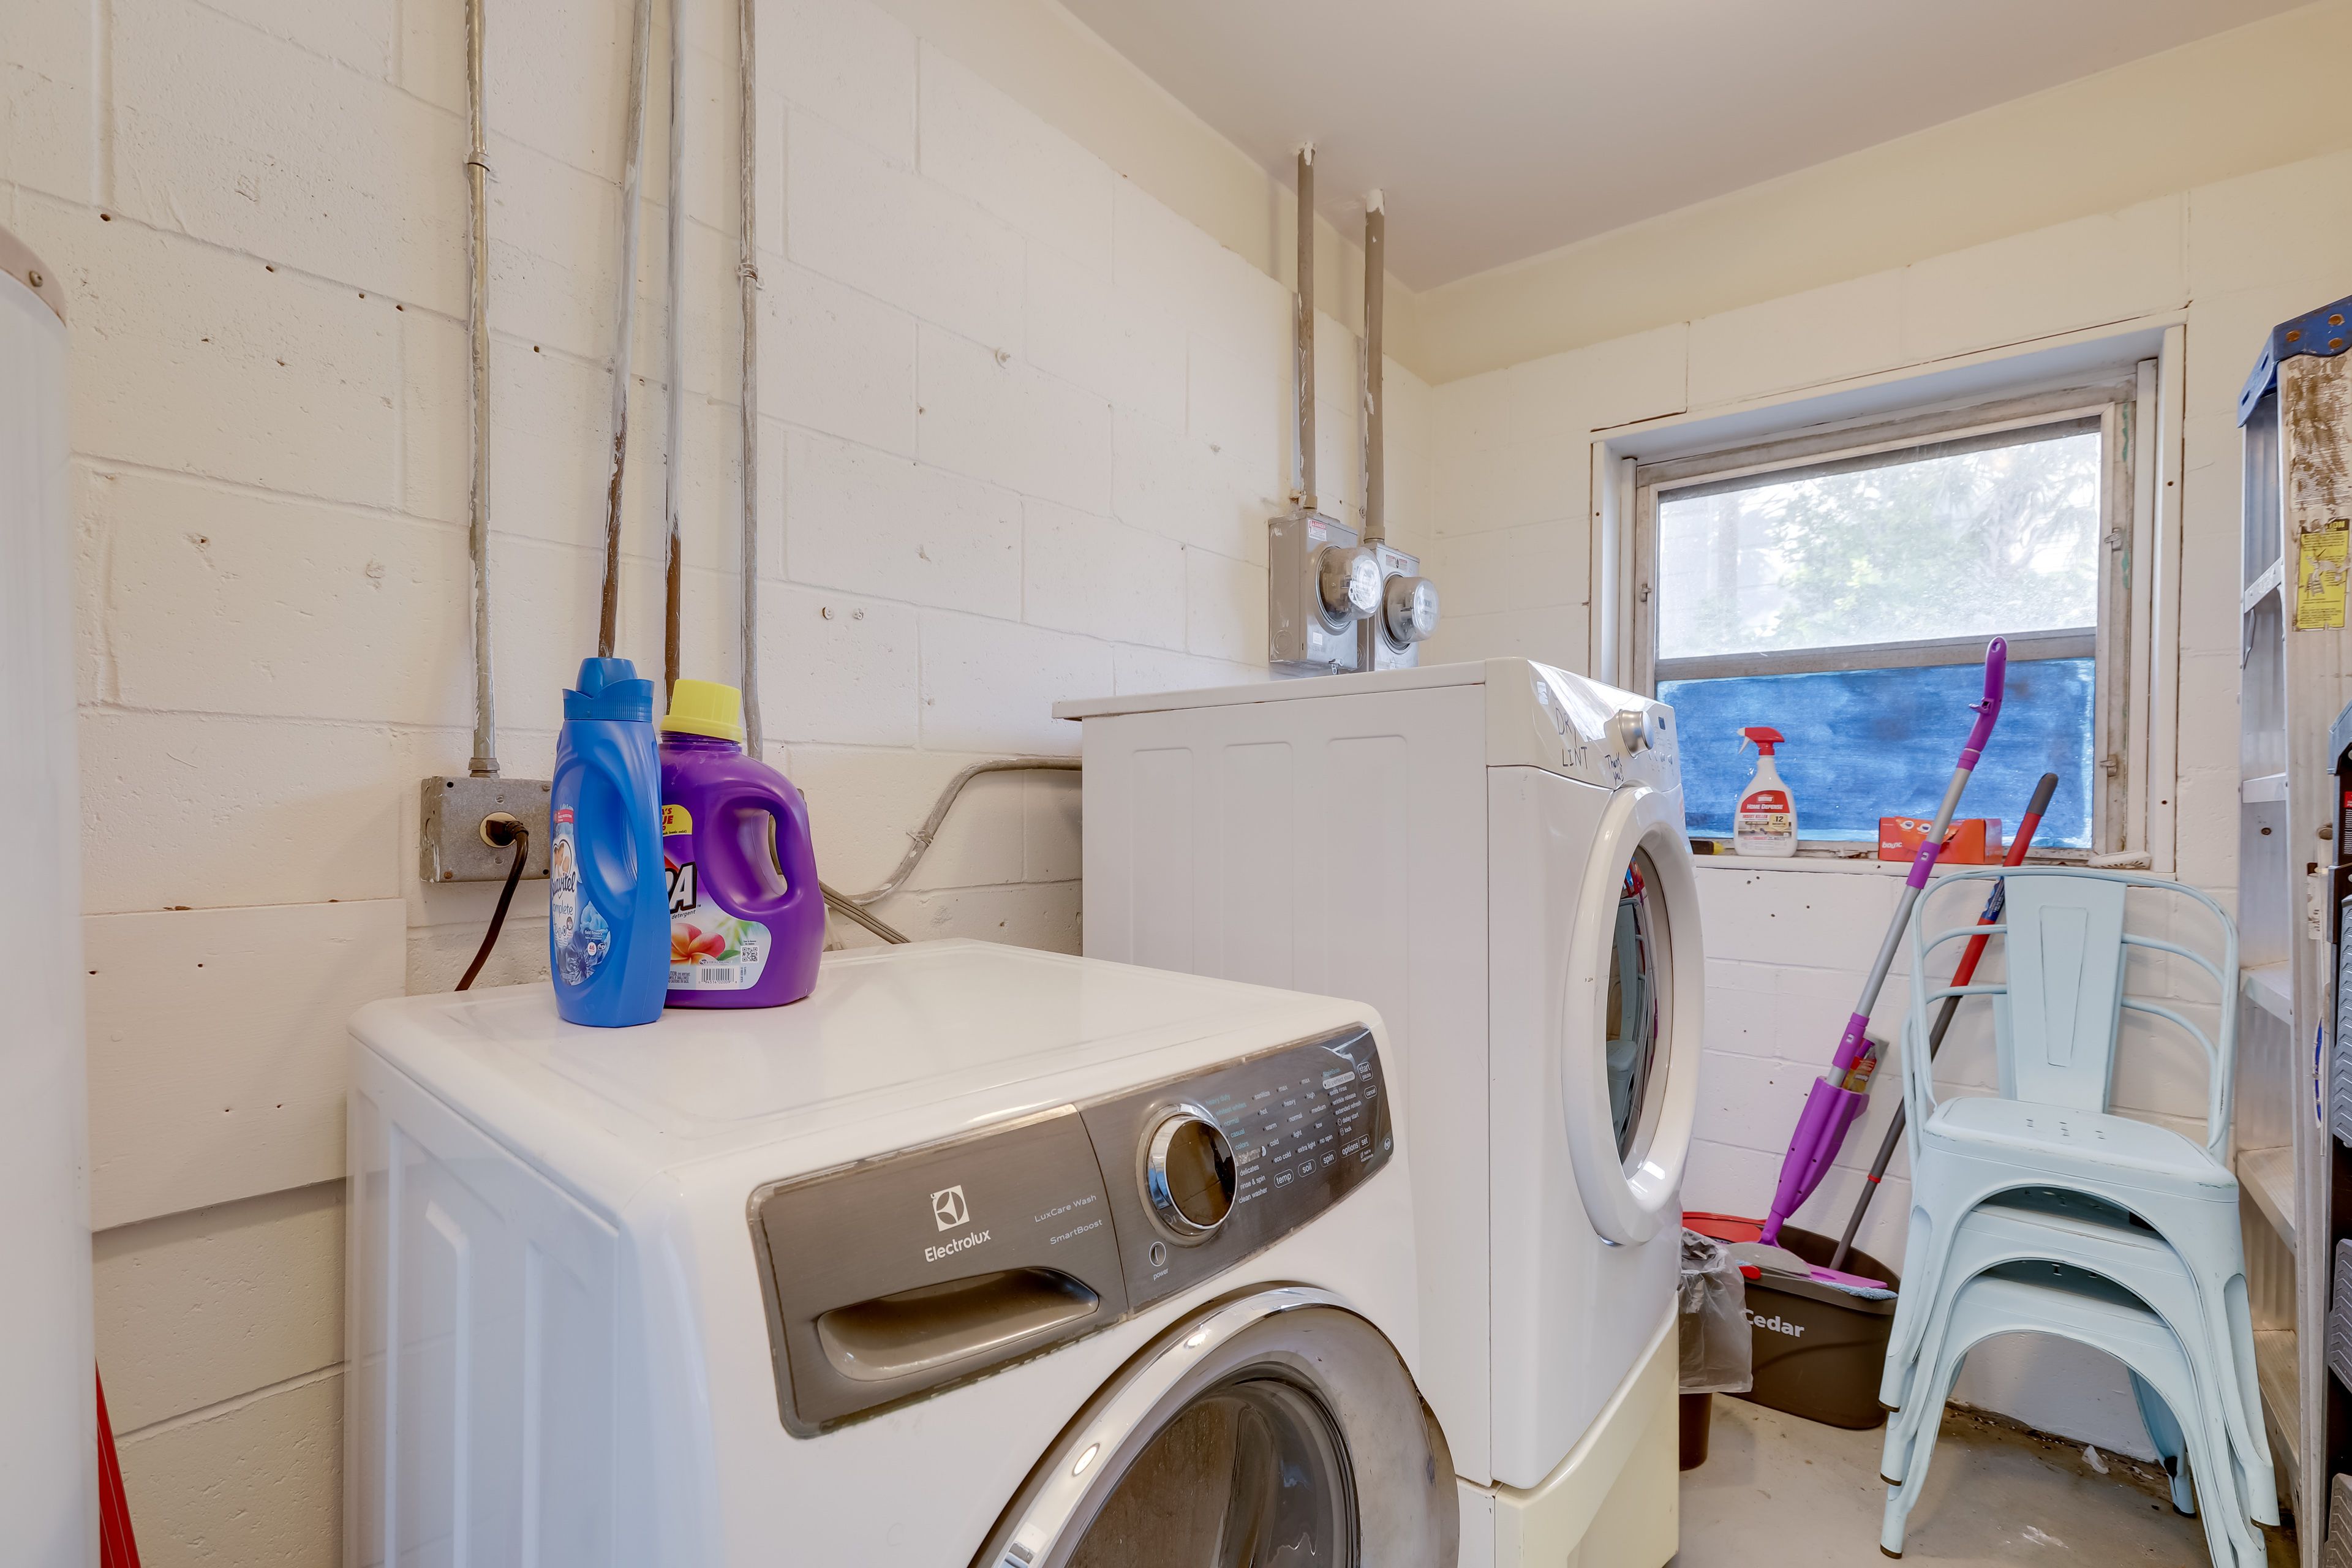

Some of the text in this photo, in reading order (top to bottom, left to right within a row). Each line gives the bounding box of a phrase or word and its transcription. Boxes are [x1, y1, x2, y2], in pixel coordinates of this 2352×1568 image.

[1562, 746, 1588, 769] LINT
[553, 900, 573, 918] omplete
[671, 910, 696, 919] detergent
[1359, 1063, 1371, 1074] start
[1254, 1091, 1270, 1099] sanitize
[1366, 1088, 1376, 1096] cancel
[1333, 1097, 1344, 1106] wrinkle
[1311, 1104, 1326, 1114] medium
[1335, 1100, 1362, 1115] extended refresh
[1224, 1117, 1240, 1127] normal
[1289, 1112, 1303, 1122] normal
[1231, 1128, 1245, 1138] casual
[1293, 1129, 1303, 1138] light
[1325, 1134, 1333, 1142] spin
[1235, 1141, 1250, 1150] colors
[1270, 1138, 1280, 1147] cold
[1297, 1140, 1316, 1153] extra light
[1342, 1142, 1359, 1155] options
[1283, 1150, 1292, 1159] cold
[1323, 1153, 1334, 1164] spin
[1240, 1164, 1260, 1176] delicates
[1302, 1162, 1313, 1173] soil
[1240, 1182, 1251, 1190] rinse
[1256, 1175, 1266, 1184] spin
[1276, 1173, 1292, 1185] temp
[1238, 1187, 1268, 1204] clean washer
[1035, 1195, 1097, 1223] LuxCare Wash
[1050, 1219, 1103, 1245] SmartBoost
[924, 1230, 991, 1262] Electrolux
[1153, 1268, 1169, 1281] power
